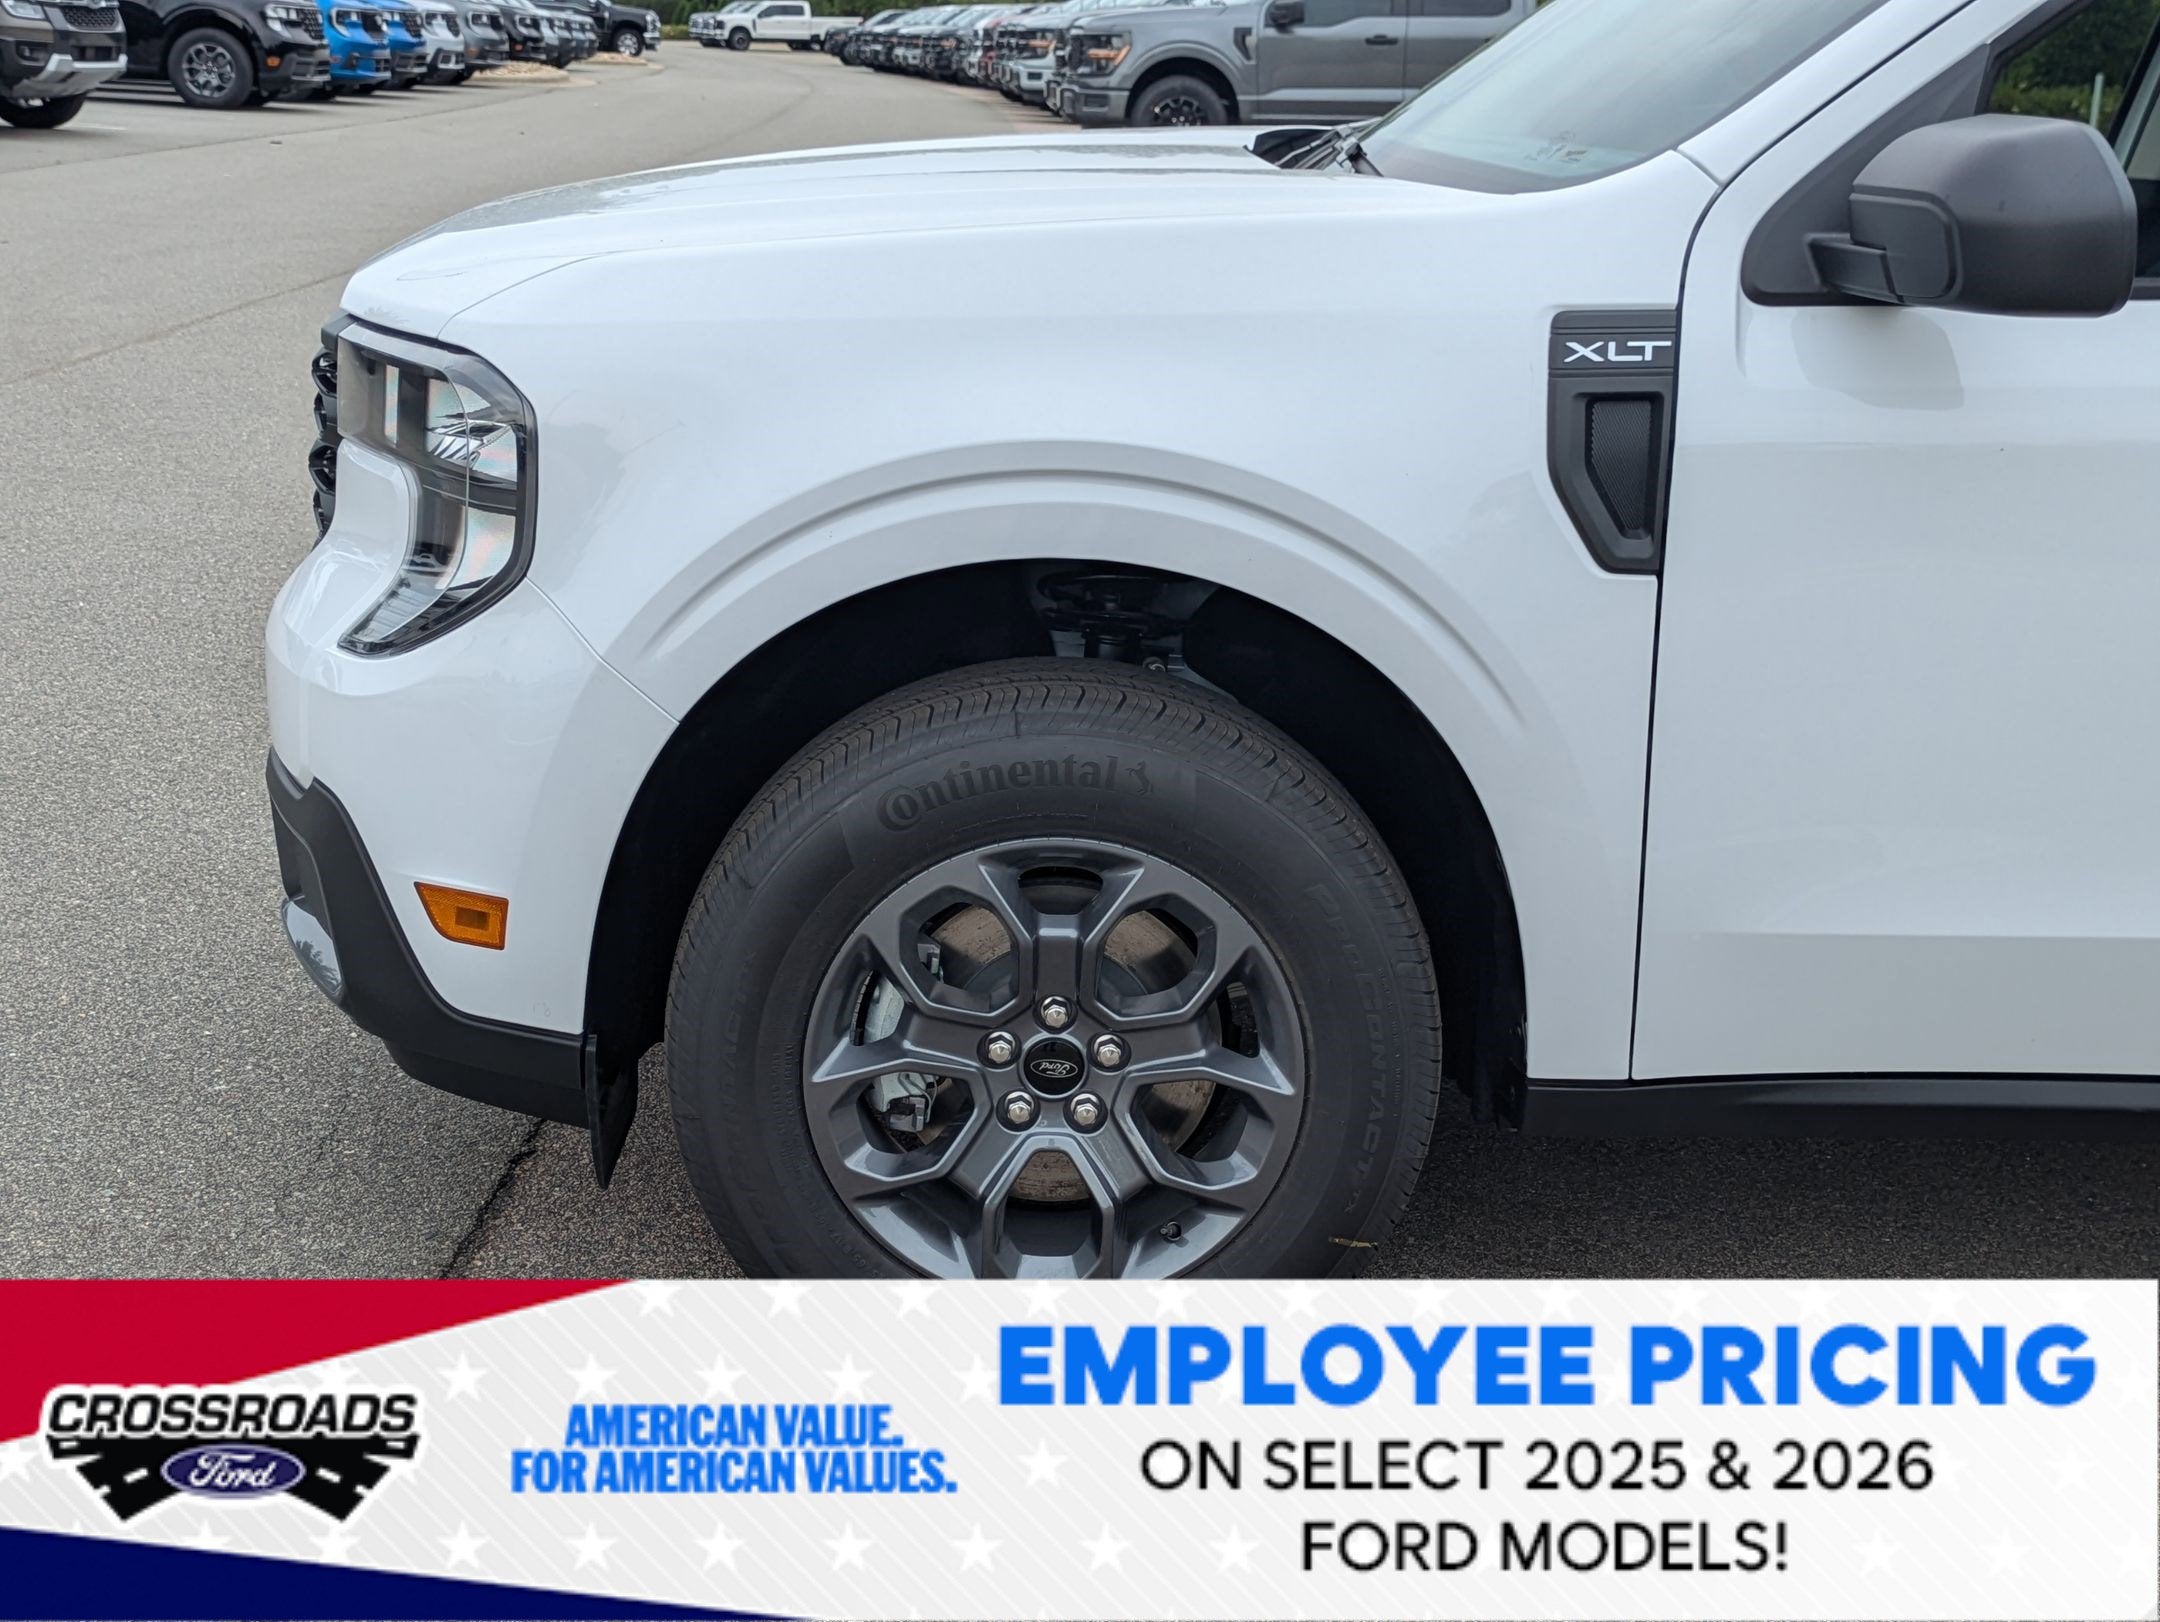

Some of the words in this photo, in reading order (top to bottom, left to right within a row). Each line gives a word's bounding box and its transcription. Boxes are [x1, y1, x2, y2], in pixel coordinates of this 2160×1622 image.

[1563, 340, 1672, 364] XLT
[877, 754, 1120, 832] Continental
[1037, 1061, 1071, 1077] Ford
